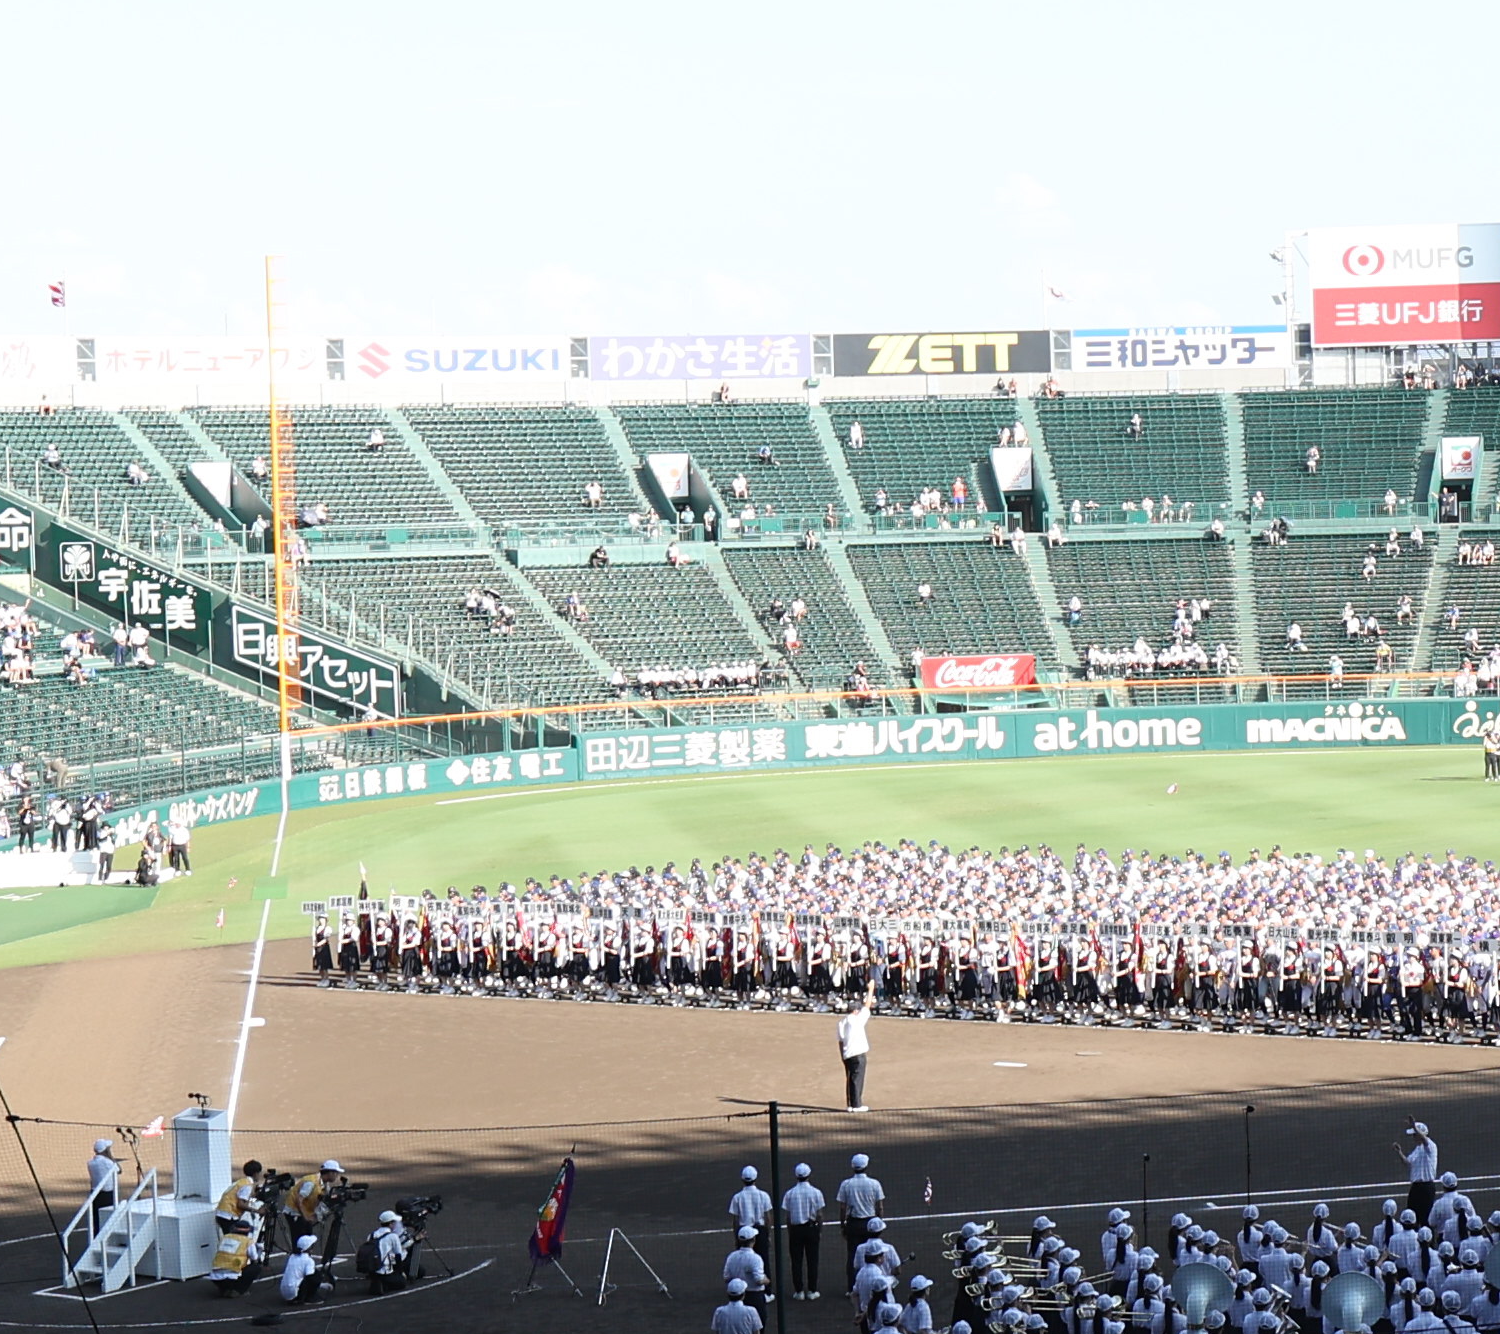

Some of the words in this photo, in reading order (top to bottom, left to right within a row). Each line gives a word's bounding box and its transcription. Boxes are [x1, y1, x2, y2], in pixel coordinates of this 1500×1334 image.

[1393, 246, 1474, 269] MUFG
[1335, 299, 1483, 327] 三菱UFJ銀行
[404, 347, 559, 373] SUZUKI
[603, 336, 801, 377] わかさ生活
[867, 333, 1018, 374] ZETT
[1085, 337, 1275, 368] 三和シャッター
[98, 566, 197, 630] 宇佐美
[238, 623, 394, 702] 日興アセット
[805, 716, 1002, 758] 東進ハイスクール
[1034, 722, 1075, 751] at
[1080, 710, 1201, 749] home
[586, 728, 787, 771] 田辺三菱製薬
[470, 752, 565, 784] 住友電工
[392, 897, 416, 908] 明豊
[868, 920, 897, 931] 日大三
[903, 921, 932, 932] 市船橋
[1182, 924, 1208, 936] 北海
[1222, 926, 1252, 937] 花巻東
[1268, 927, 1298, 938] 日大山形
